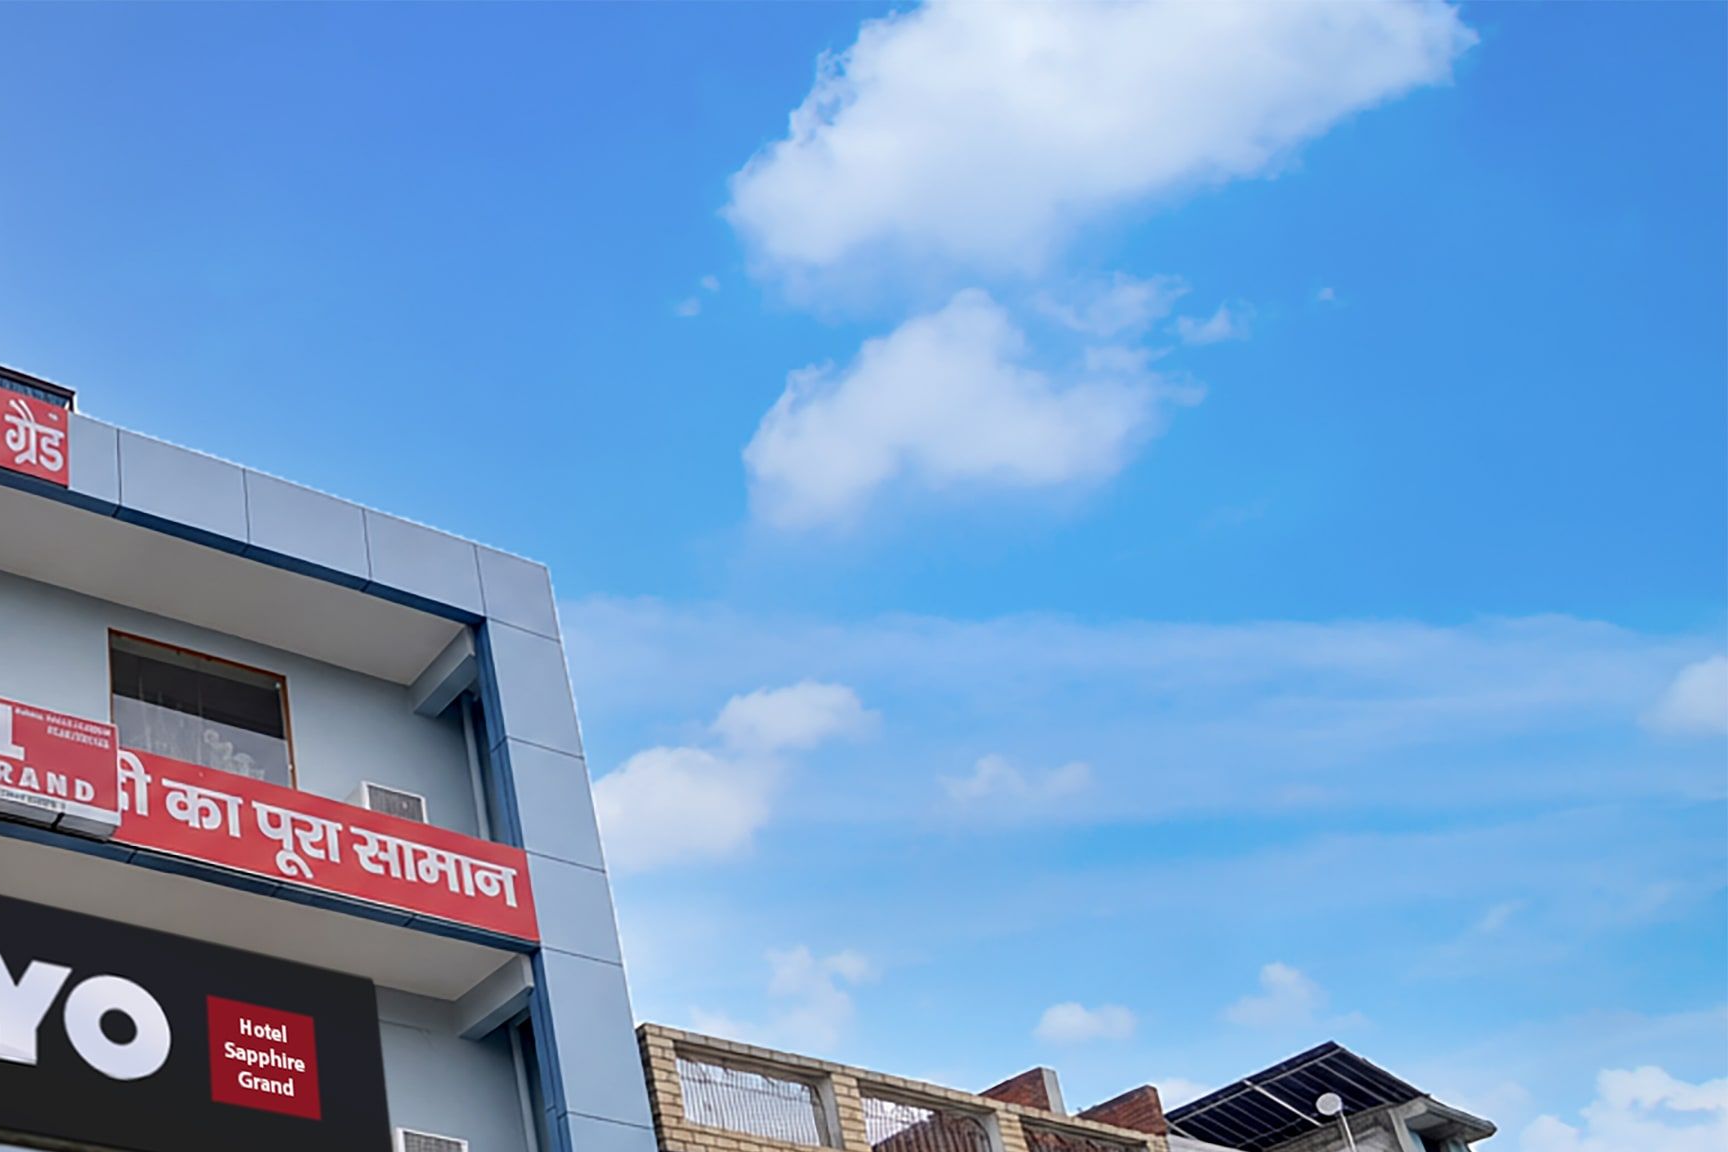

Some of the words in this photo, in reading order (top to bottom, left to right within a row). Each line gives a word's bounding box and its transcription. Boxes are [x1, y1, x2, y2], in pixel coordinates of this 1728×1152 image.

[162, 777, 244, 839] का
[252, 800, 342, 879] पूरा
[350, 826, 518, 908] सामान
[240, 1018, 287, 1043] Hotel
[224, 1041, 306, 1072] Sapphire
[238, 1071, 294, 1097] Grand
